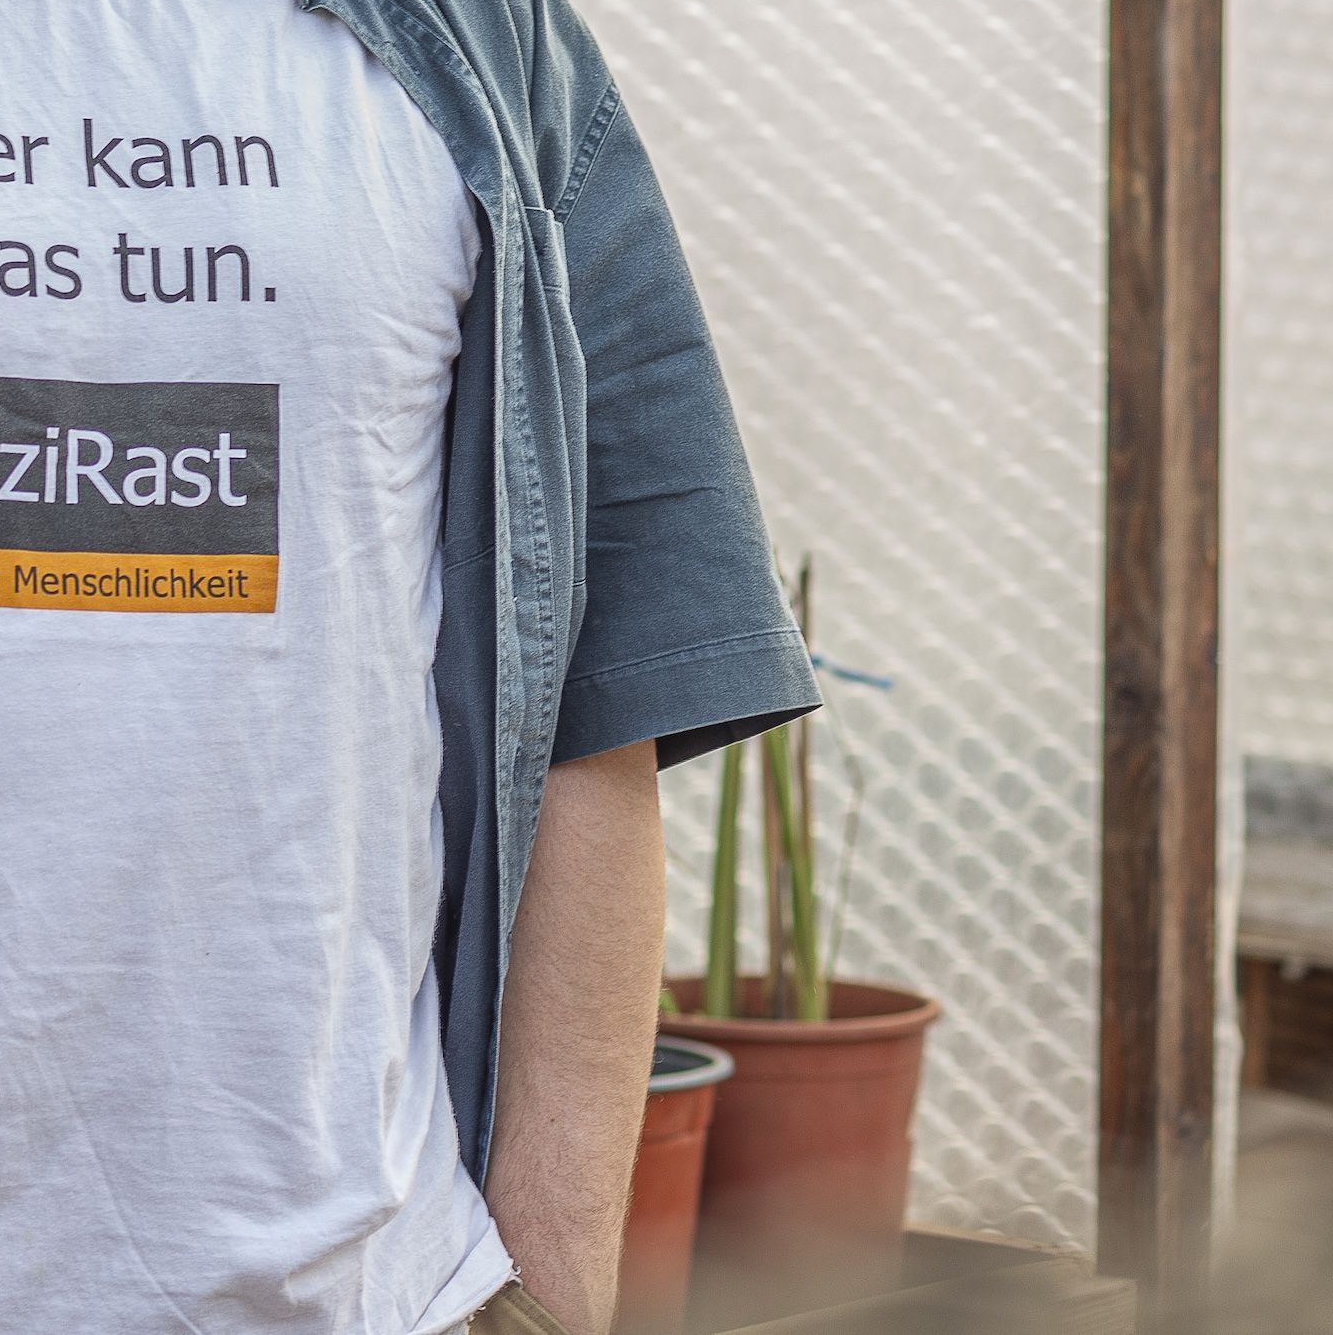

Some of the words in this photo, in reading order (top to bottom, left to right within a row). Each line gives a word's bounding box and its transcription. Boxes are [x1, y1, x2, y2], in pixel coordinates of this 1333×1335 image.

[83, 118, 280, 189] kann
[113, 232, 277, 304] tun.
[14, 564, 249, 599] Menschlichkeit
